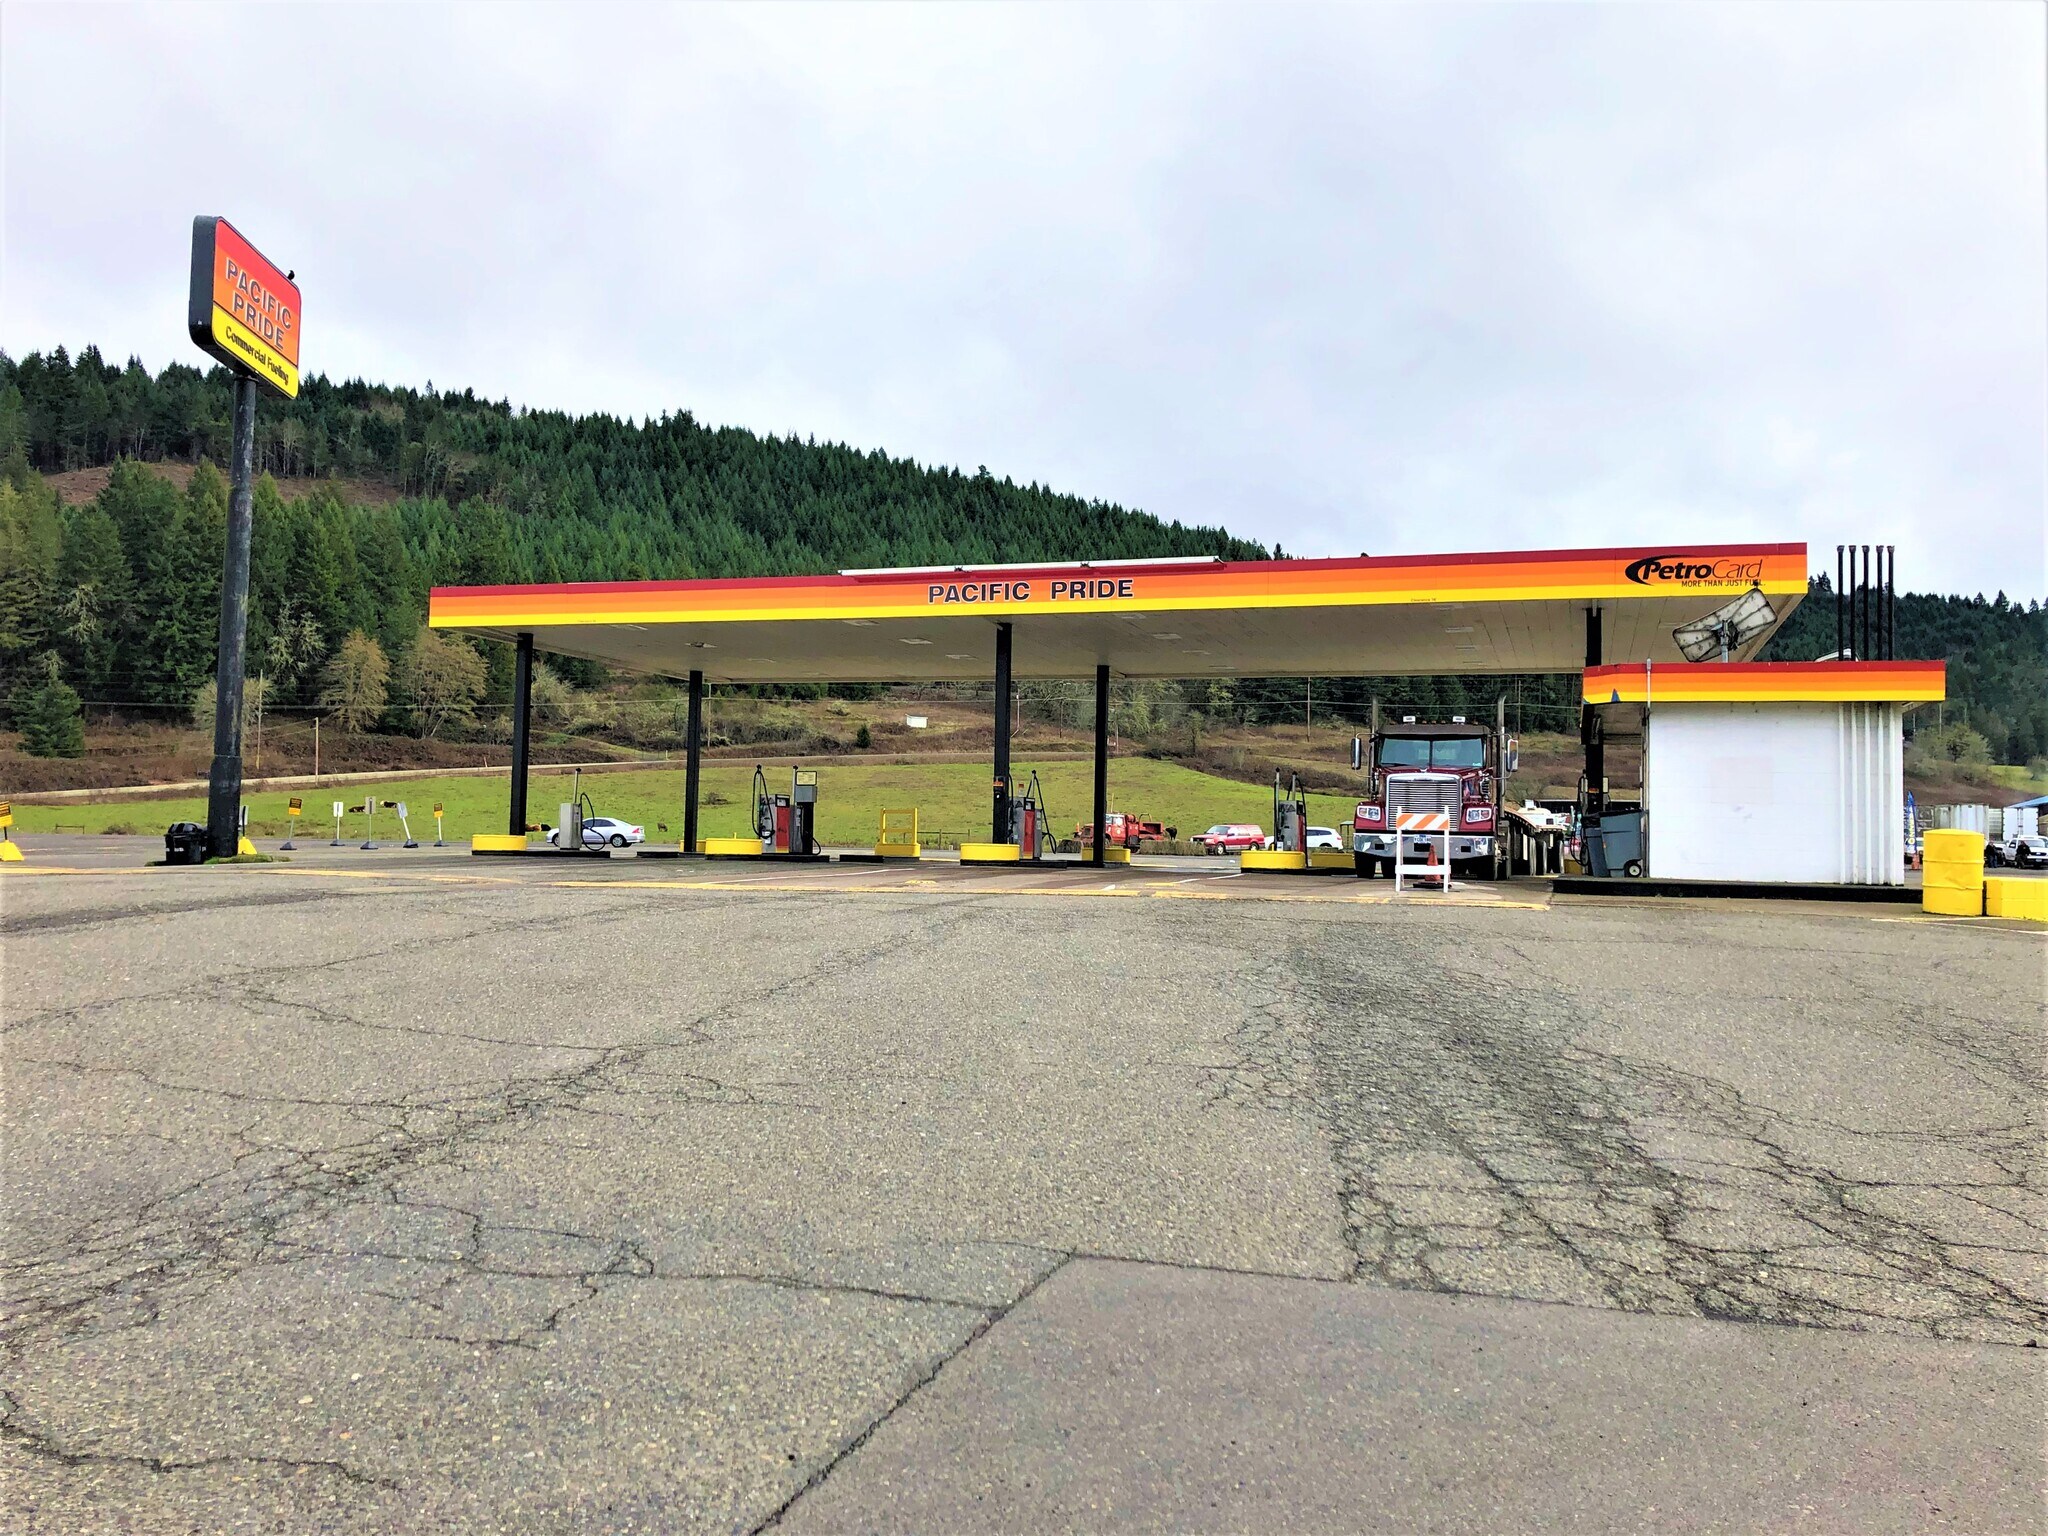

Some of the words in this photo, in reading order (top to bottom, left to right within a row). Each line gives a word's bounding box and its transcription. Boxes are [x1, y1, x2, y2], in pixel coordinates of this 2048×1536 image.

[226, 257, 292, 330] PACIFIC
[233, 292, 285, 350] PRIDE
[225, 326, 267, 365] Commercial
[267, 358, 289, 386] Fueling
[1642, 559, 1763, 580] PetroCard
[1681, 580, 1701, 588] MORE
[1725, 579, 1743, 587] JUST
[928, 582, 1030, 603] PACIFIC
[1050, 579, 1134, 600] PRIDE
